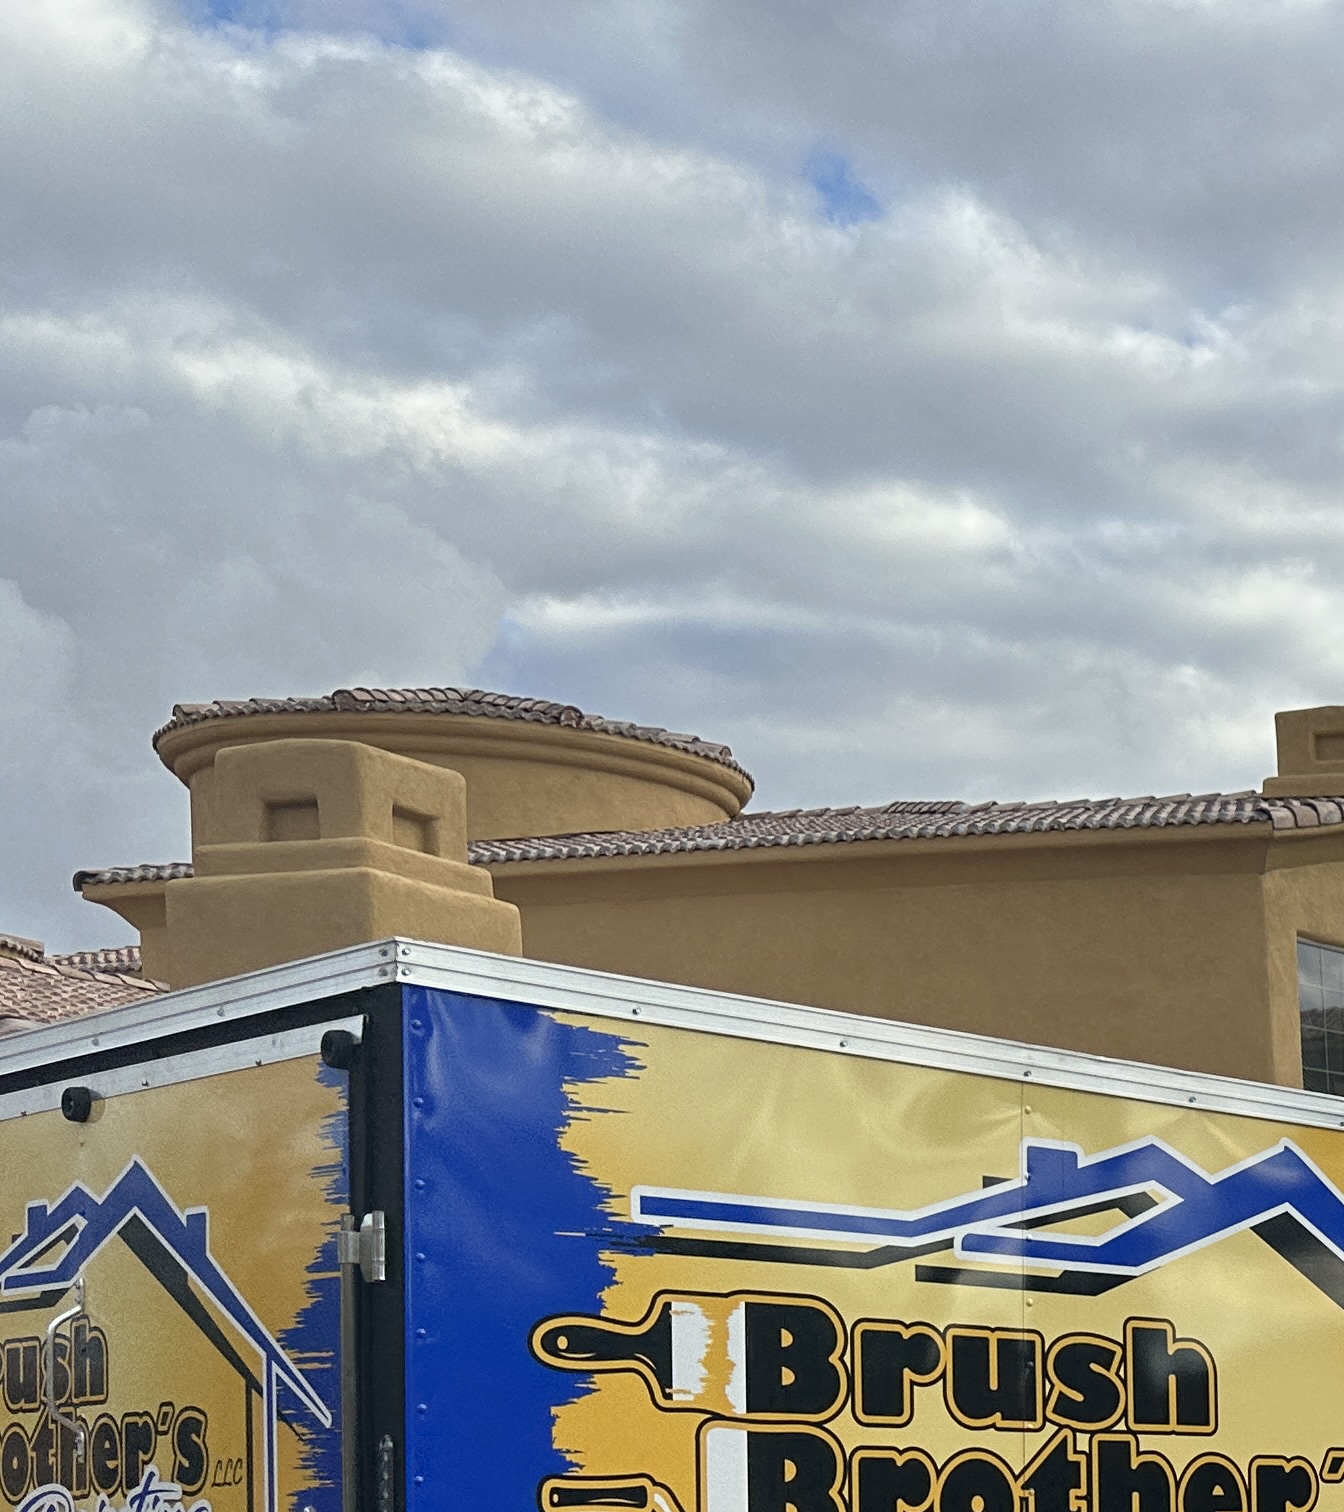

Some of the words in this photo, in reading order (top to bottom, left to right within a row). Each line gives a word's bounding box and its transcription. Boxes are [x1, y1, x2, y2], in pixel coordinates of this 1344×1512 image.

[0, 1314, 108, 1413] ush
[742, 1290, 1218, 1437] Brush
[211, 1458, 243, 1487] LLC
